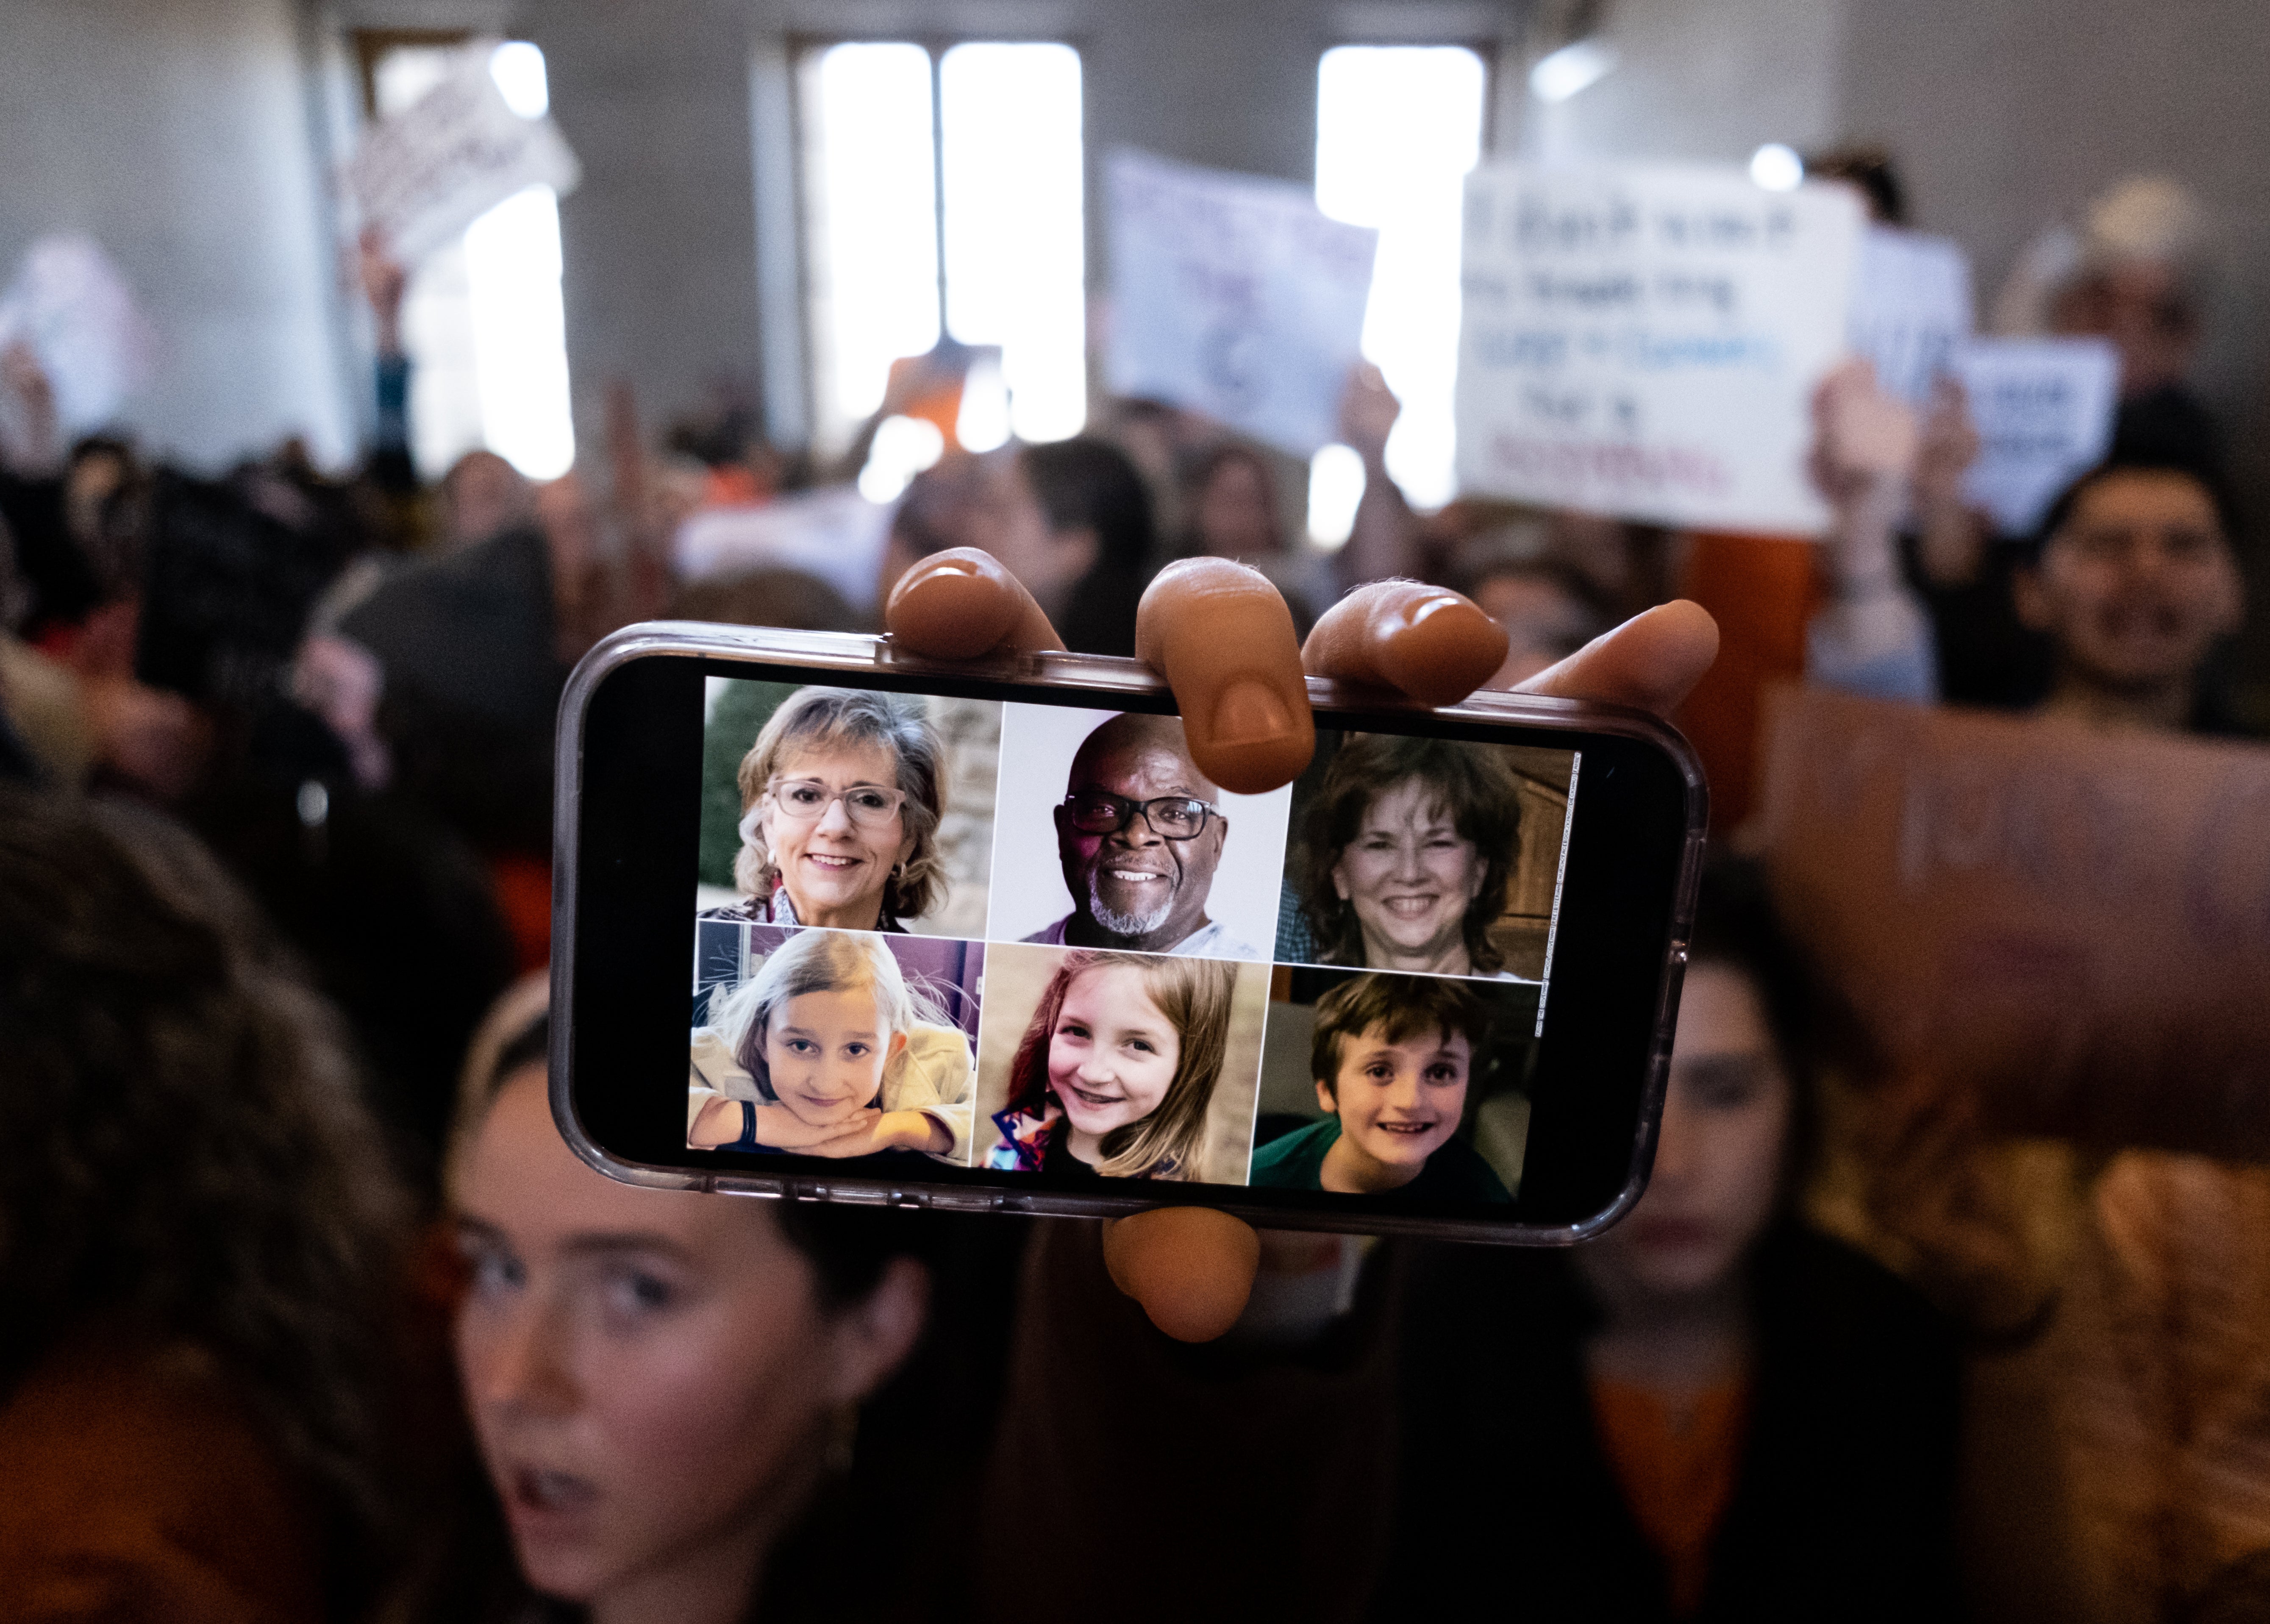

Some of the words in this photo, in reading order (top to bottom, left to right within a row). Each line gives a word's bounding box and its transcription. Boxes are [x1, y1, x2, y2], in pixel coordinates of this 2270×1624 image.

[1539, 979, 1548, 1008] COVENANT
[1551, 884, 1562, 924] PRESBYTERIAN
[1572, 753, 1580, 773] FAMILY
